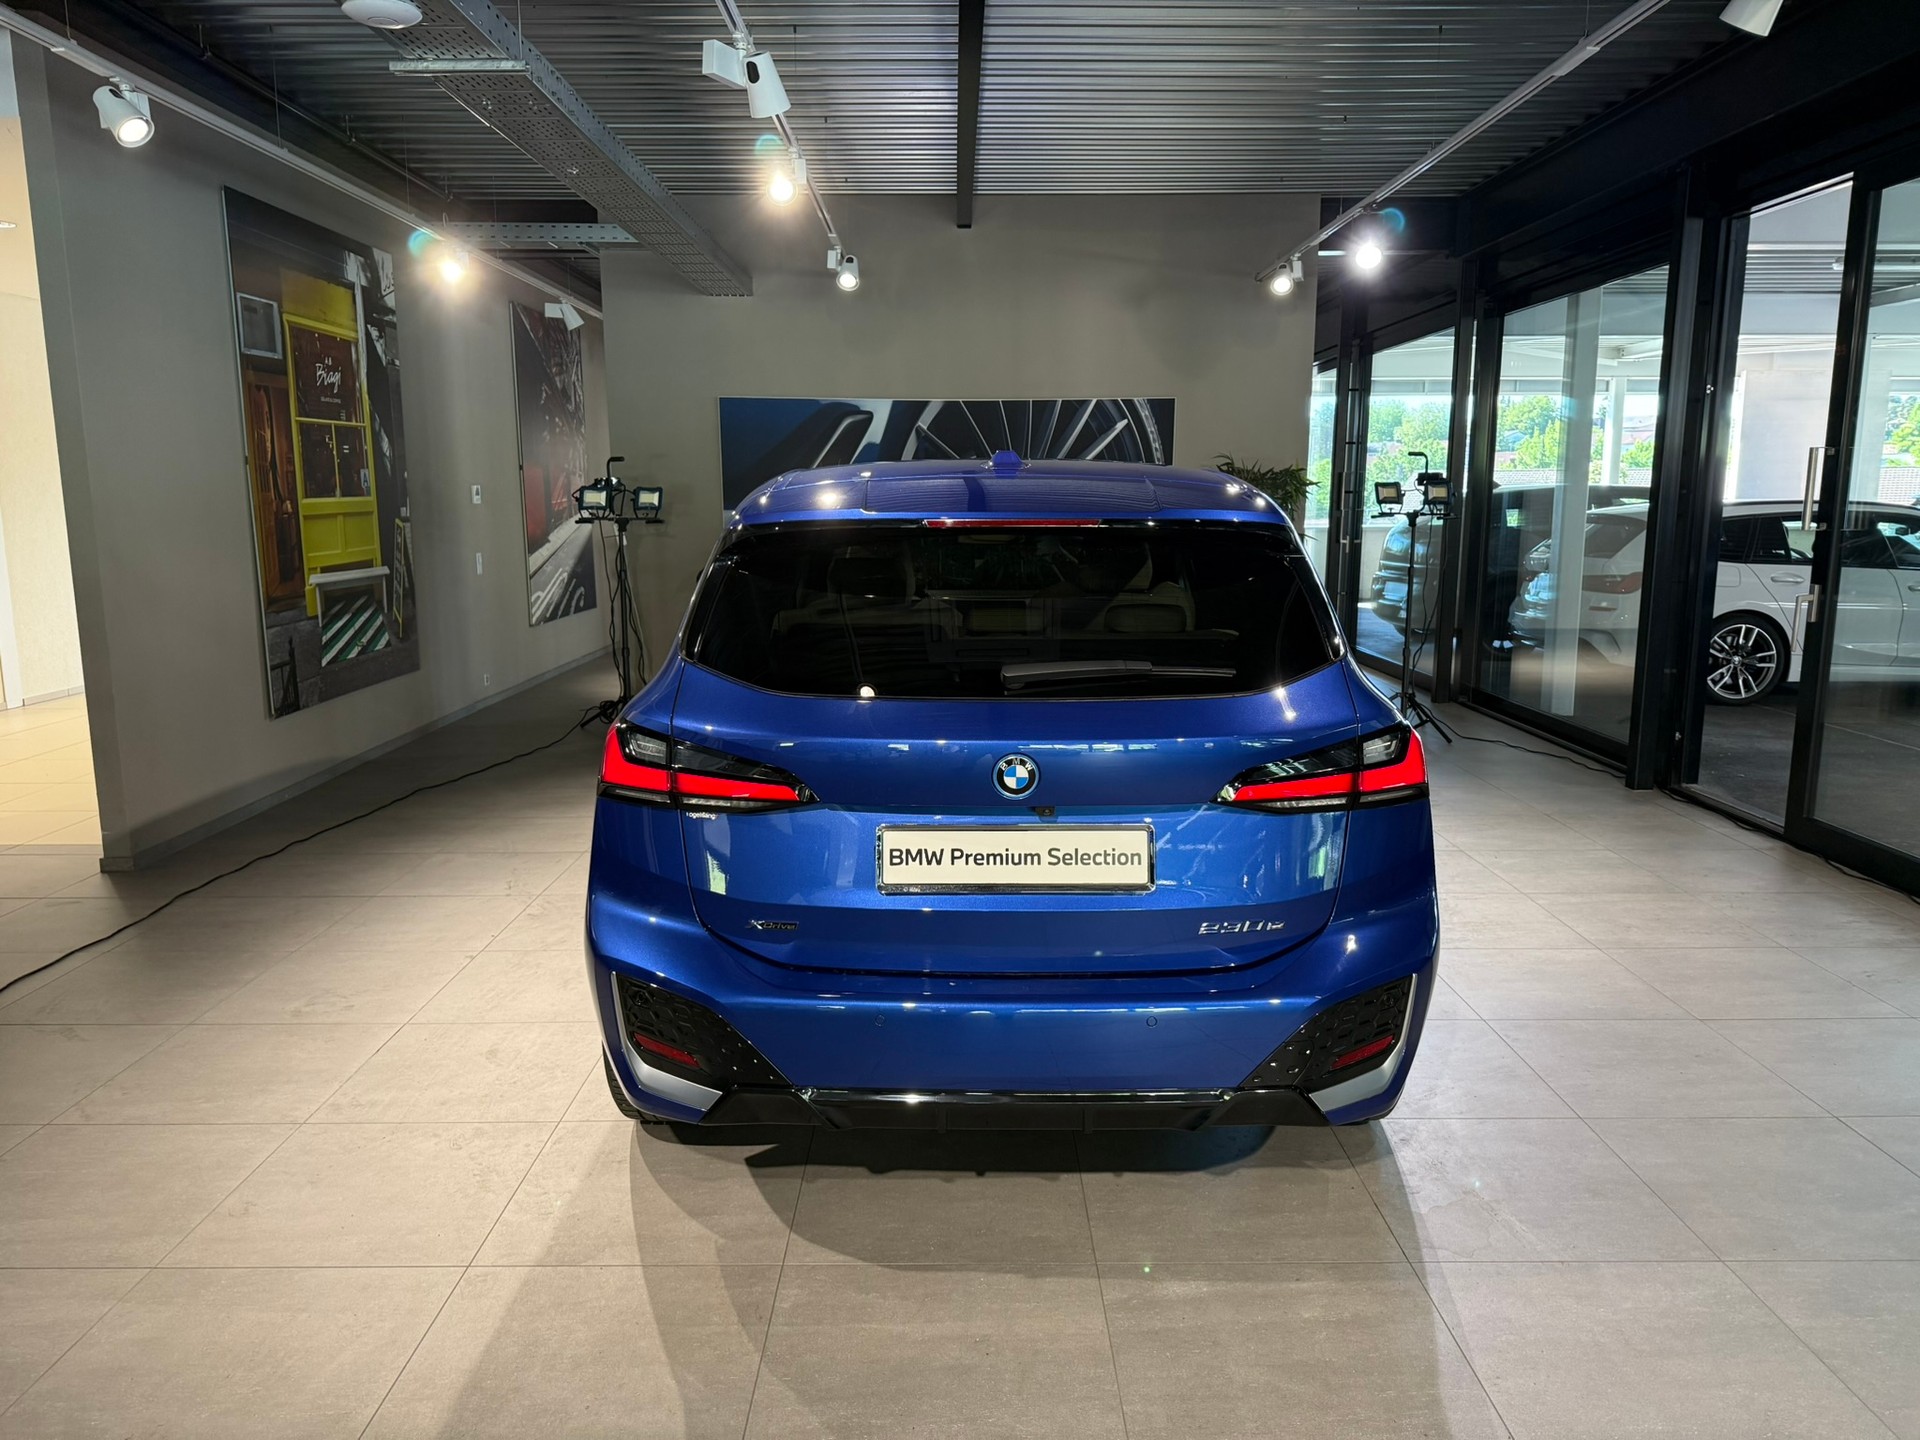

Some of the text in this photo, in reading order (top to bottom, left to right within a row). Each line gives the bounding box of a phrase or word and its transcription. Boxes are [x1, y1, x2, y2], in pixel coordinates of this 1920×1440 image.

[315, 363, 342, 394] Biagi
[1000, 757, 1034, 771] BMW
[888, 847, 1143, 866] BMW Premium Selection
[1198, 919, 1286, 935] 230e
